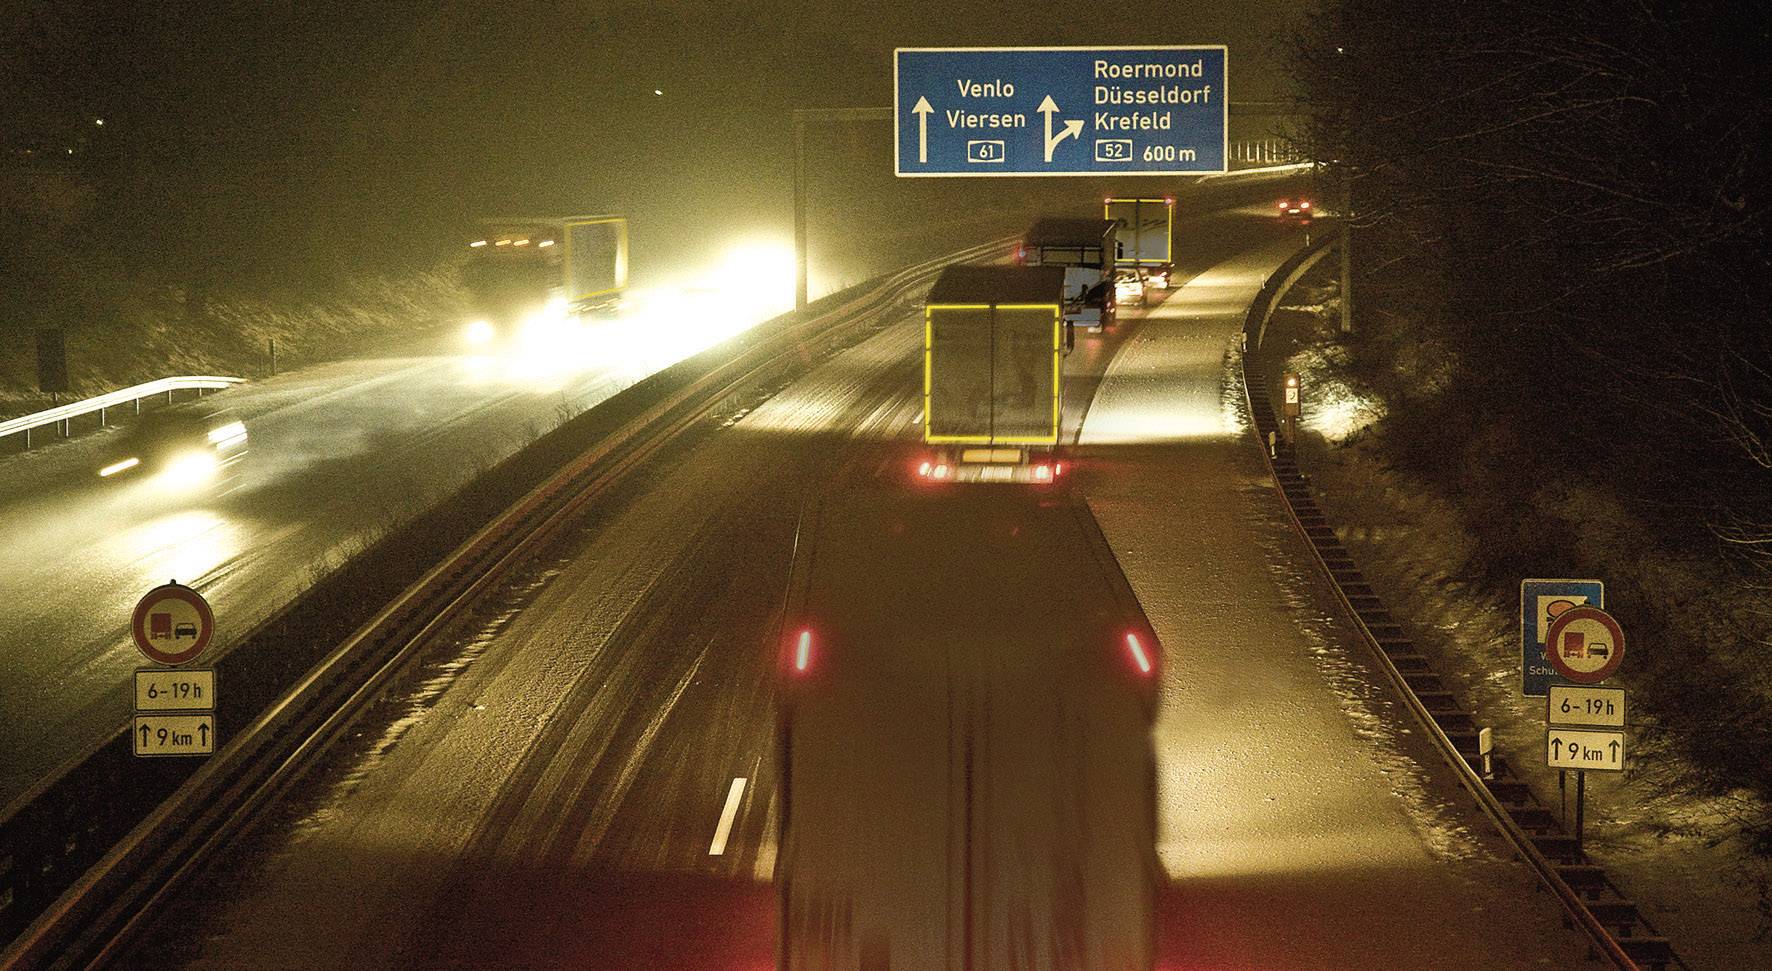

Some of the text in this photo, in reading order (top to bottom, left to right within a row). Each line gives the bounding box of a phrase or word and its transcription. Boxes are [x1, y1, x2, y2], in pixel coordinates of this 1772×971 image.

[1094, 59, 1202, 78] Roermond
[957, 79, 1015, 97] Venlo
[1094, 85, 1211, 105] Düsseldorf
[946, 110, 1026, 129] Viersen
[1094, 111, 1172, 130] Krefeld
[979, 145, 994, 159] 61
[1105, 144, 1122, 158] 52
[1143, 145, 1196, 162] 600 m
[157, 728, 192, 746] 9 km
[1568, 743, 1603, 761] 9 km
